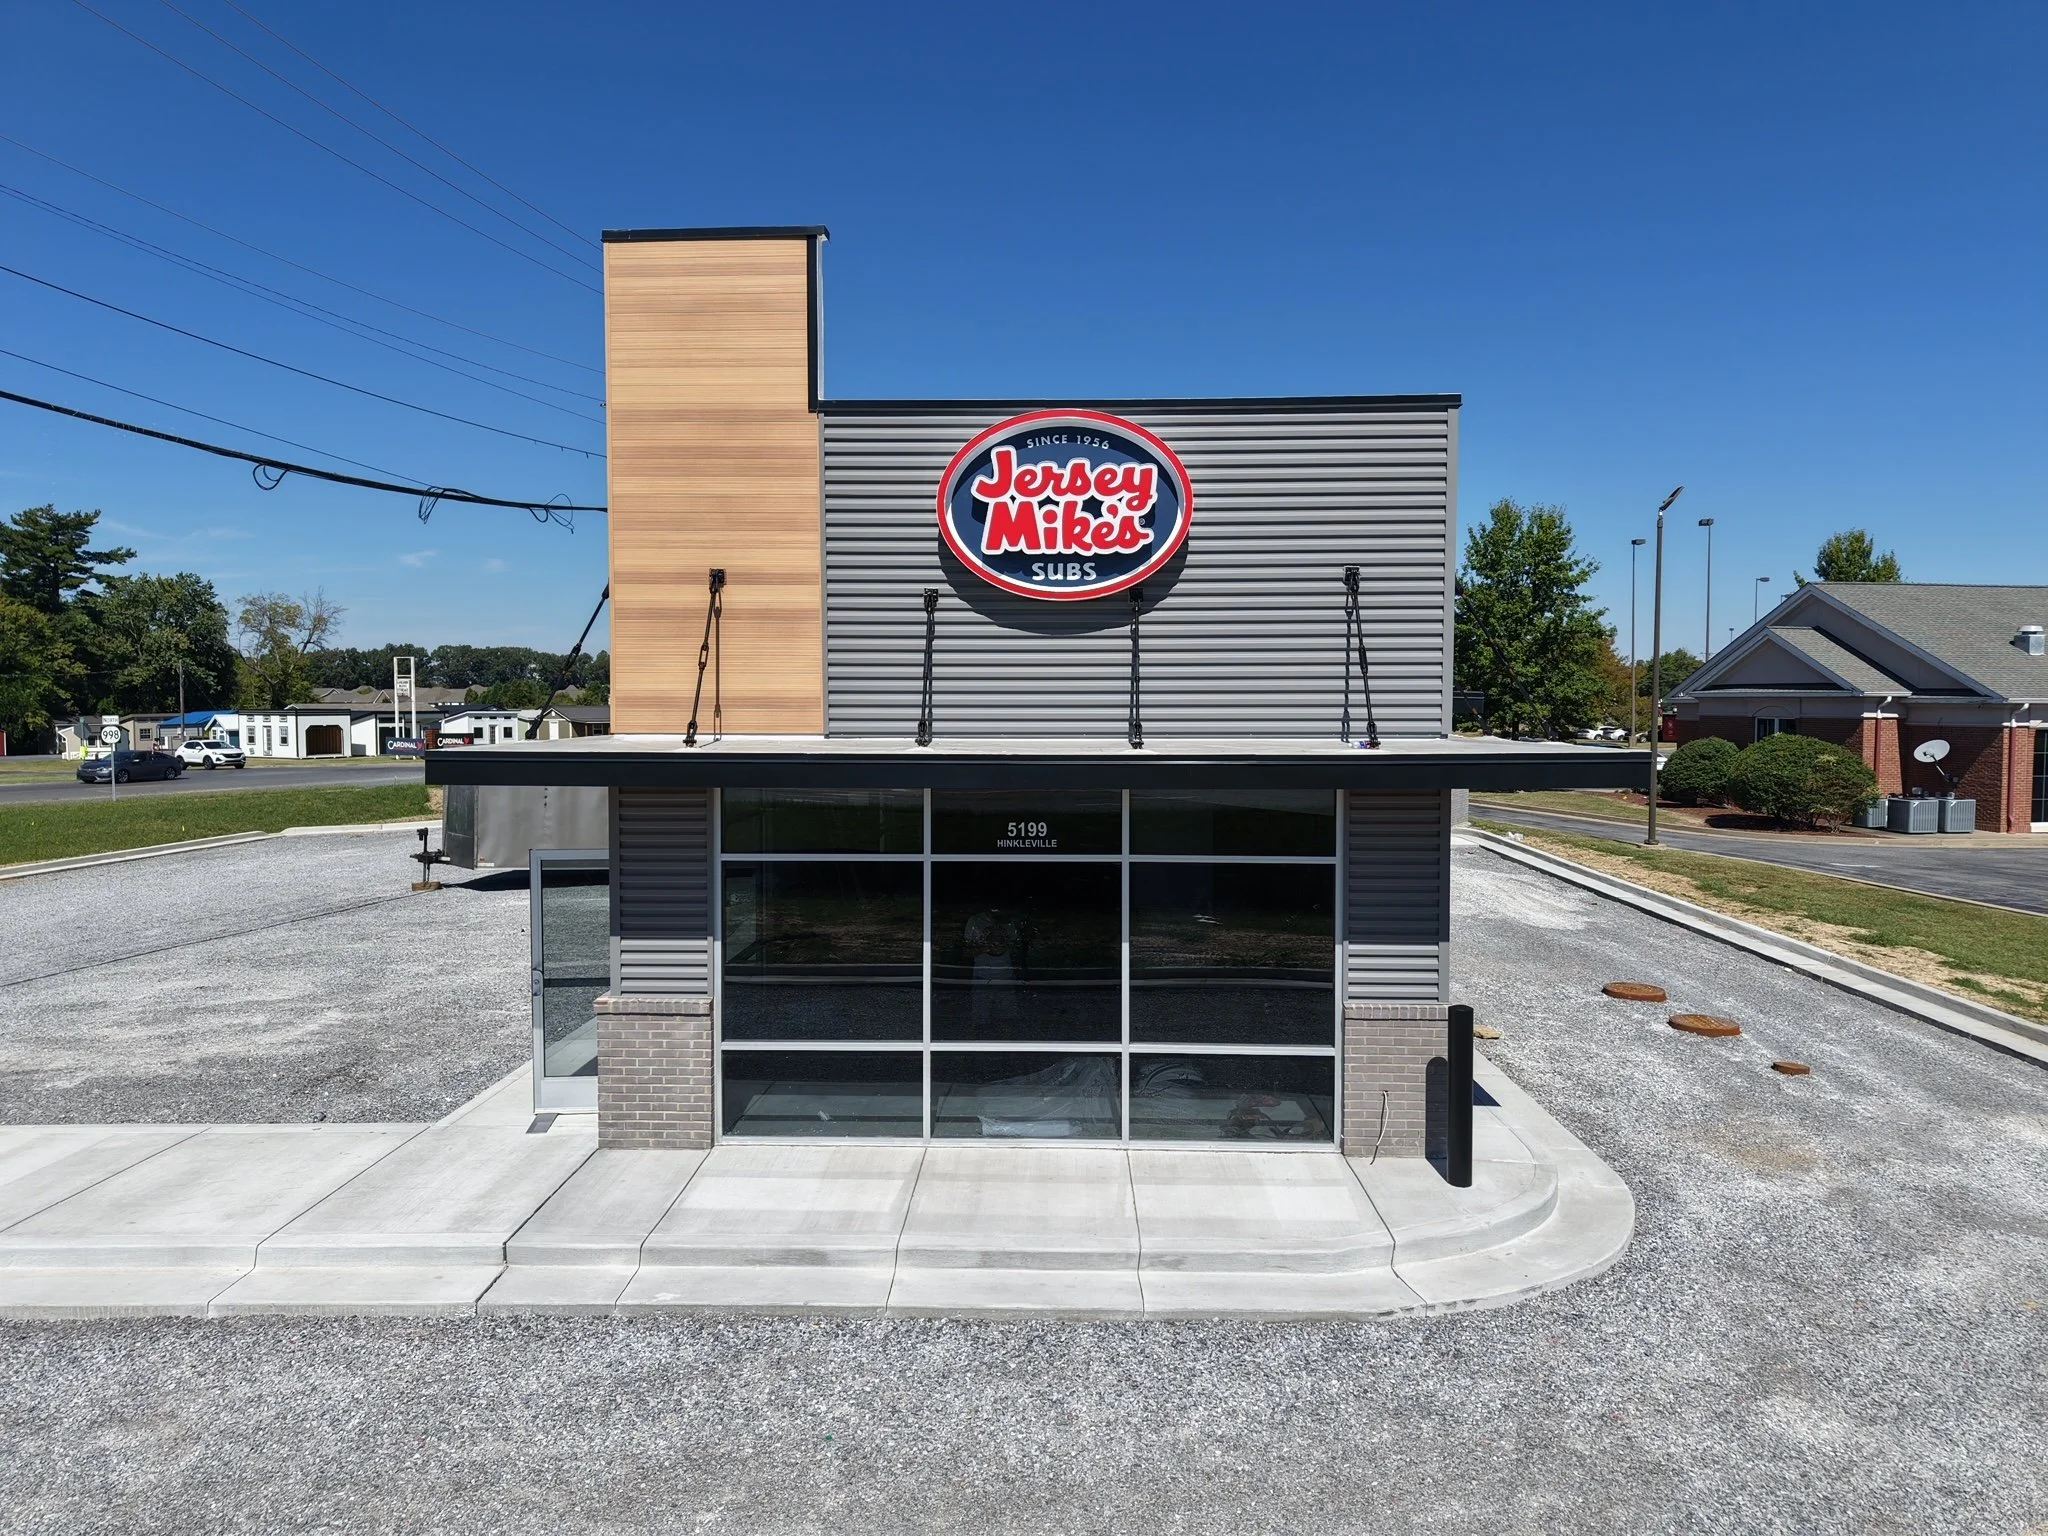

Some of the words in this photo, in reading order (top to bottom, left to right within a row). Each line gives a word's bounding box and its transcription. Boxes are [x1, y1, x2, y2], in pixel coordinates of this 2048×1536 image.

[1026, 434, 1068, 449] SINCE
[1076, 435, 1110, 450] 1956
[973, 447, 1155, 513] Jersey
[983, 499, 1152, 553] Mike's
[1031, 562, 1097, 581] SUBS
[103, 730, 119, 740] 998
[437, 737, 464, 747] CARDINAL
[387, 740, 417, 750] CARDINAL
[1007, 821, 1048, 837] 5199
[997, 839, 1058, 848] HINKLEVILLE
